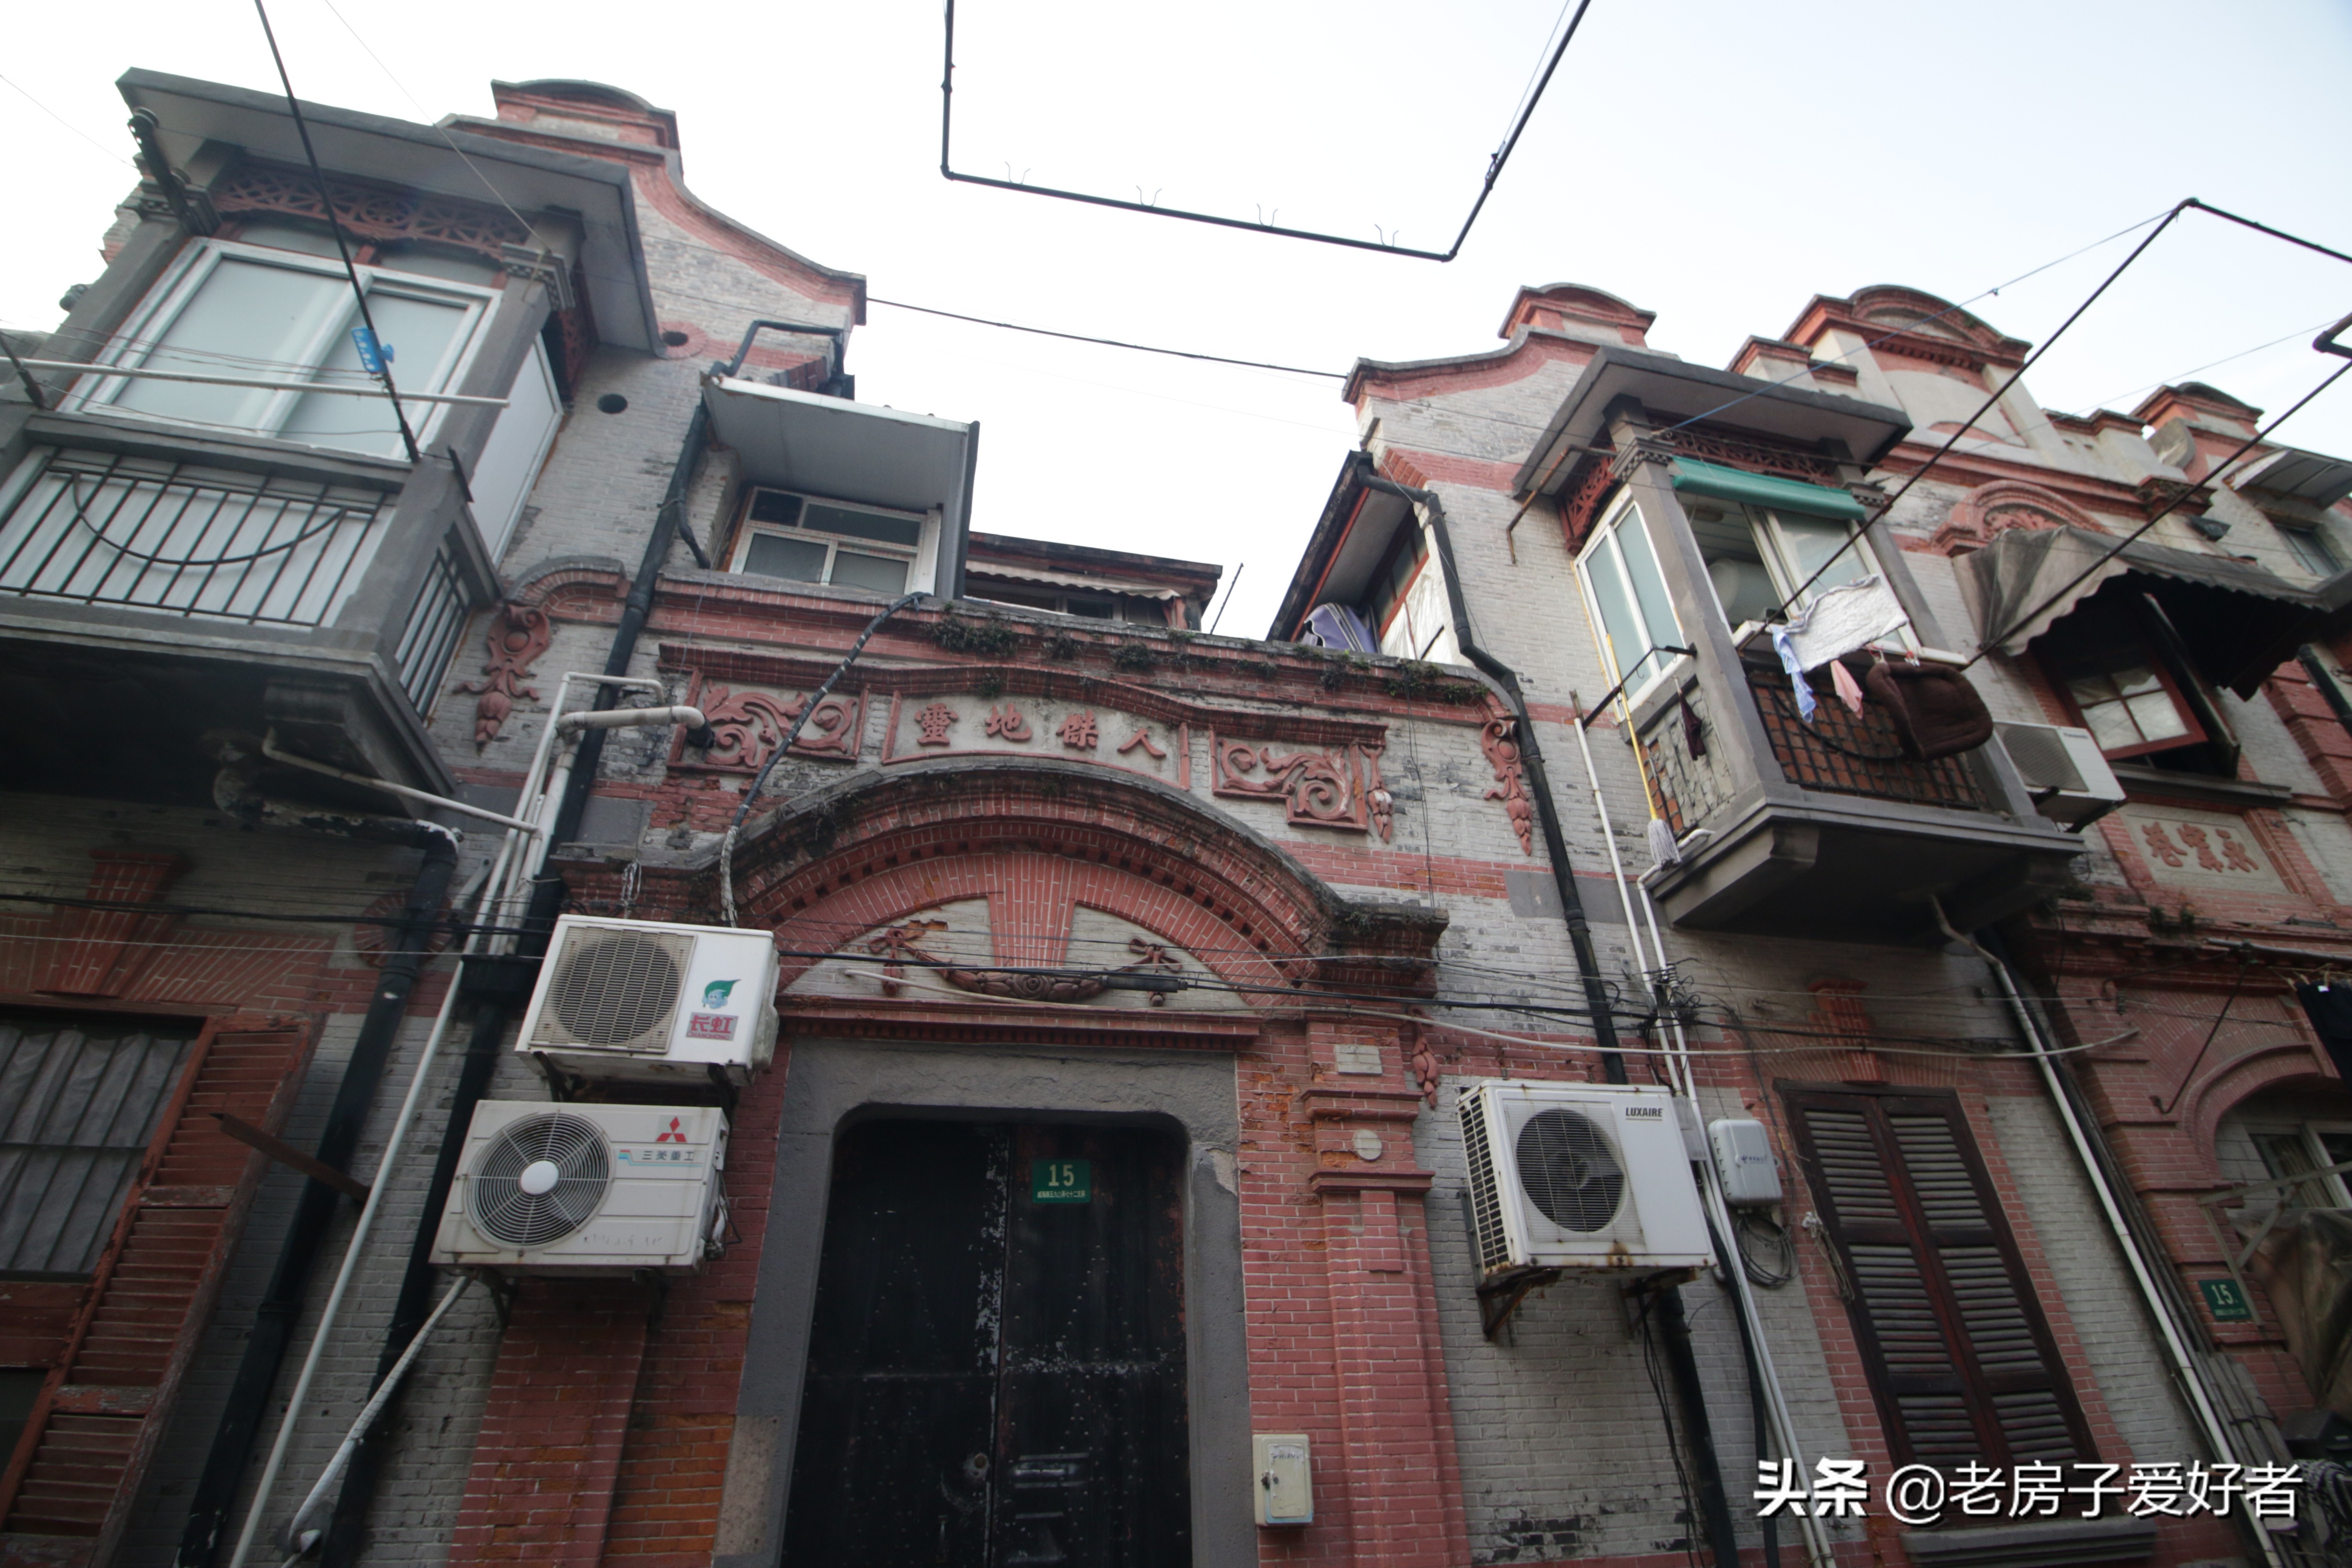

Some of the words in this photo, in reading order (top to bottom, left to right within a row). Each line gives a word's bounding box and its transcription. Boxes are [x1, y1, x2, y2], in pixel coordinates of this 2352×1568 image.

[690, 1014, 734, 1034] 长虹
[686, 1030, 730, 1041] CHANGHONG
[1625, 1107, 1663, 1117] LUXAIRE
[642, 1150, 695, 1161] 三菱重工
[1048, 1164, 1075, 1186] 15
[2211, 1283, 2234, 1305] 15
